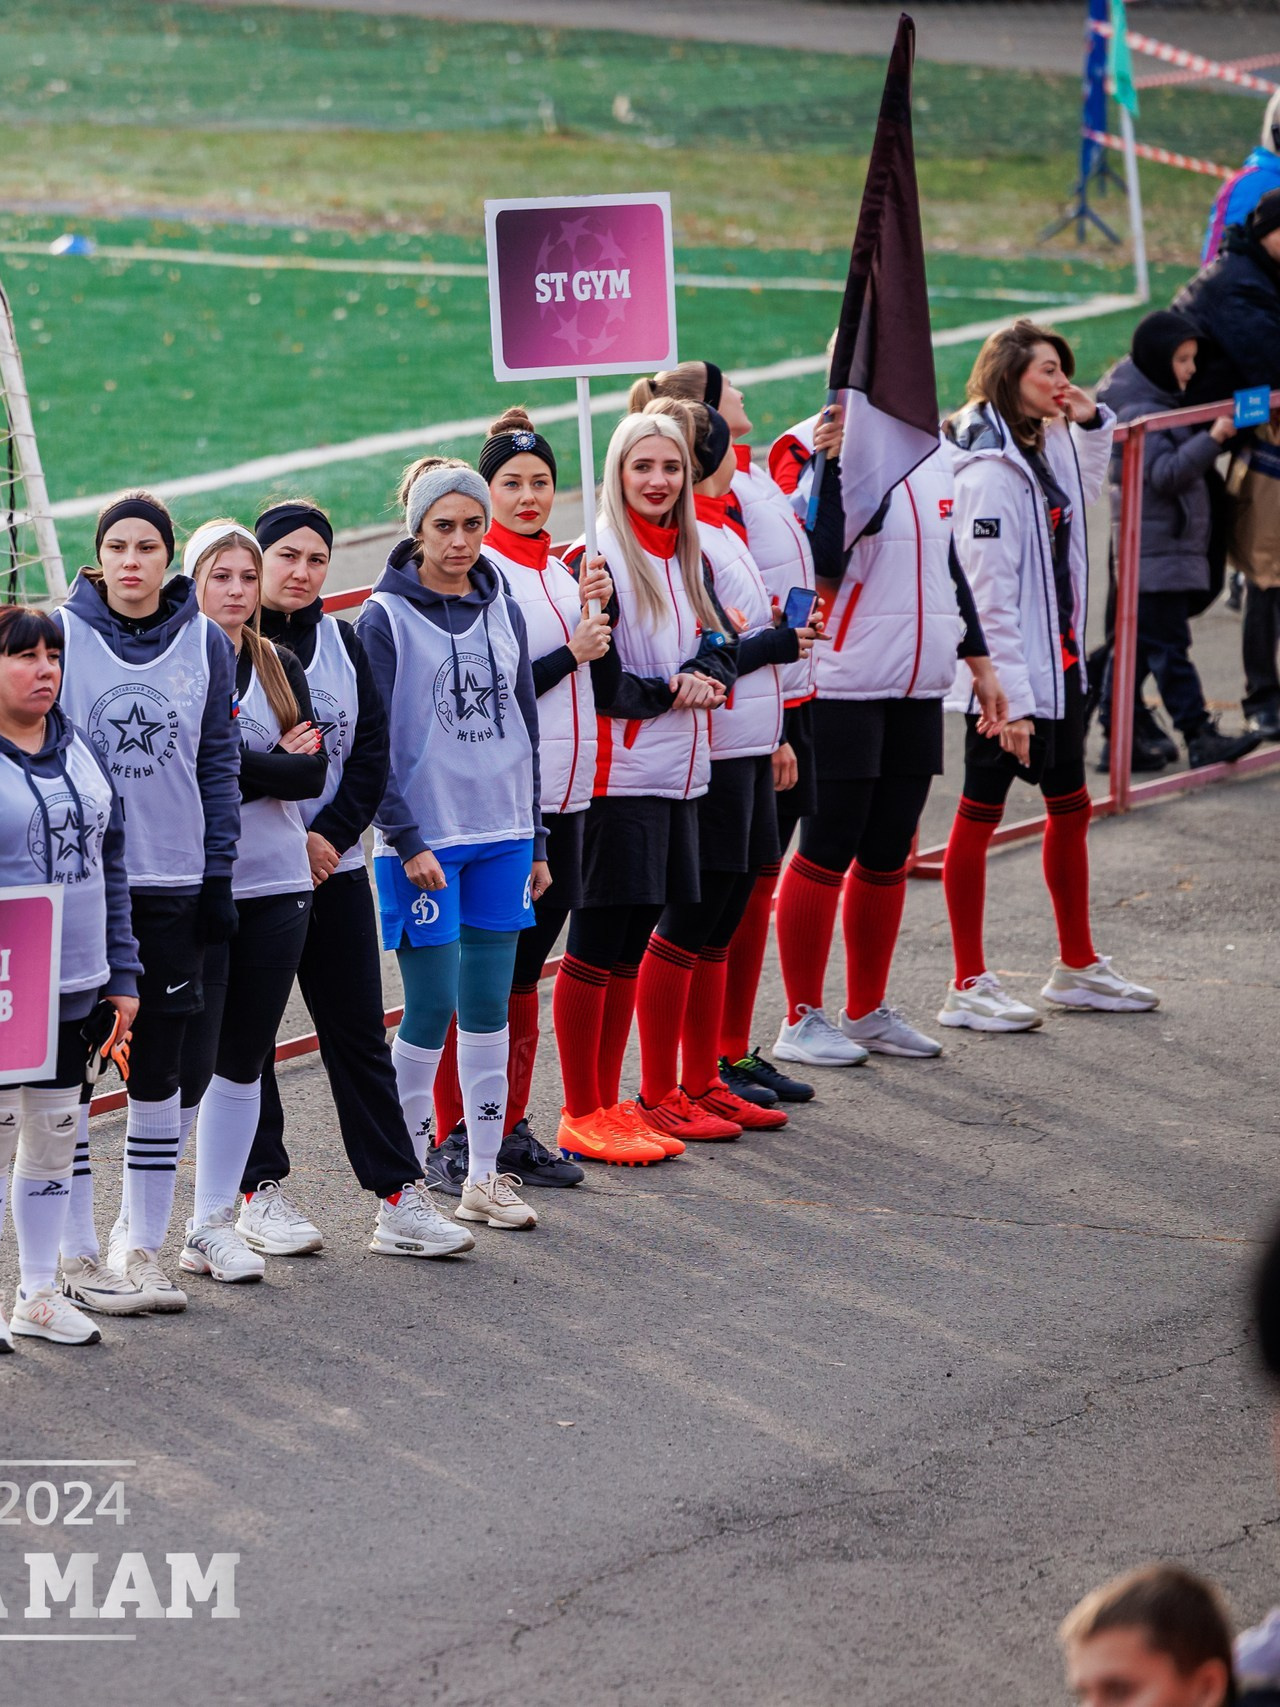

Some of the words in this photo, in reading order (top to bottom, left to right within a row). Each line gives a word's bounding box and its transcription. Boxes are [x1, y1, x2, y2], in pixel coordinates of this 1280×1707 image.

[535, 272, 568, 303] ST
[572, 269, 632, 301] GYM
[111, 762, 154, 779] ЖЁНЫ
[157, 710, 179, 767] ГЕРОЕВ
[457, 727, 494, 742] ЖЁНЫ
